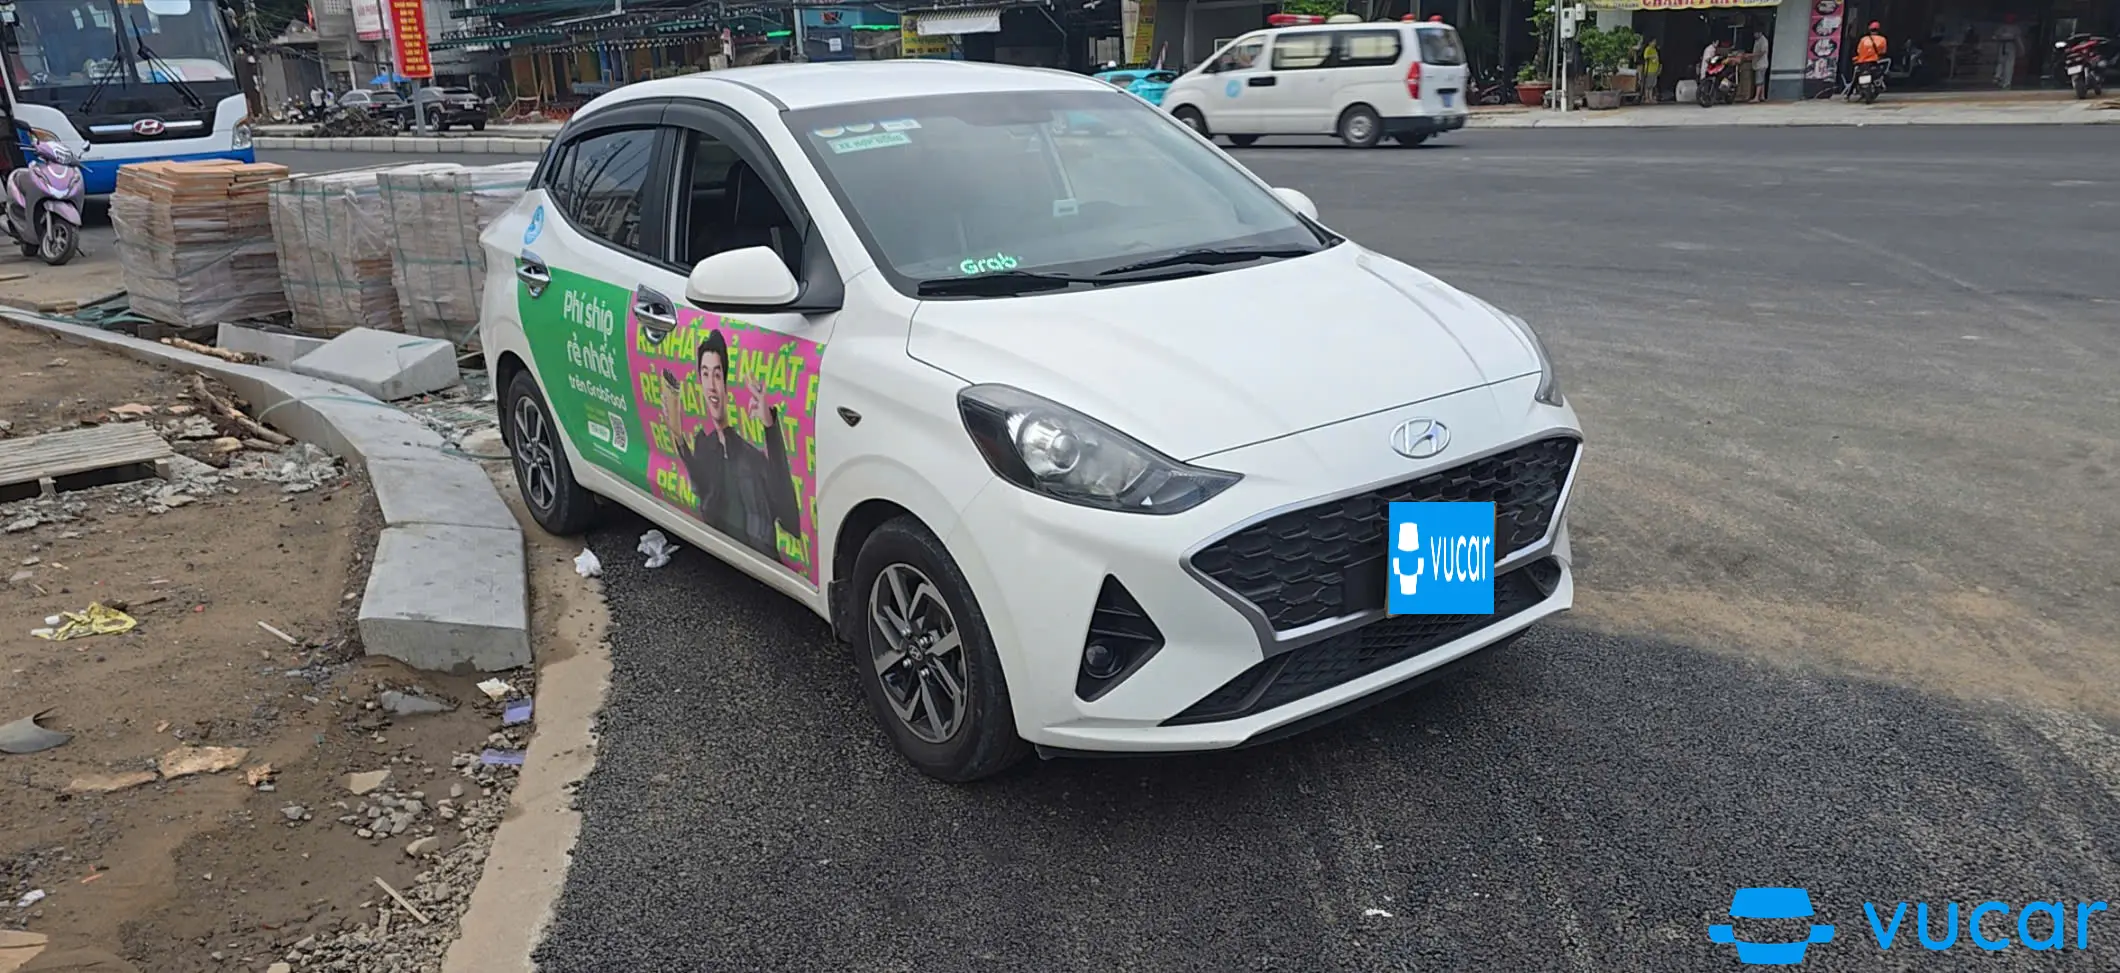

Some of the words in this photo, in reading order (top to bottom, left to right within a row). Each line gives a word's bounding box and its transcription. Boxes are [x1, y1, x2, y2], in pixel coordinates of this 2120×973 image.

[960, 252, 1018, 274] Grab
[563, 289, 586, 325] Phí
[585, 296, 614, 342] ship
[567, 331, 583, 366] rẻ
[738, 341, 804, 394] NHẤT
[568, 374, 588, 395] trên
[587, 380, 627, 412] GrabFood
